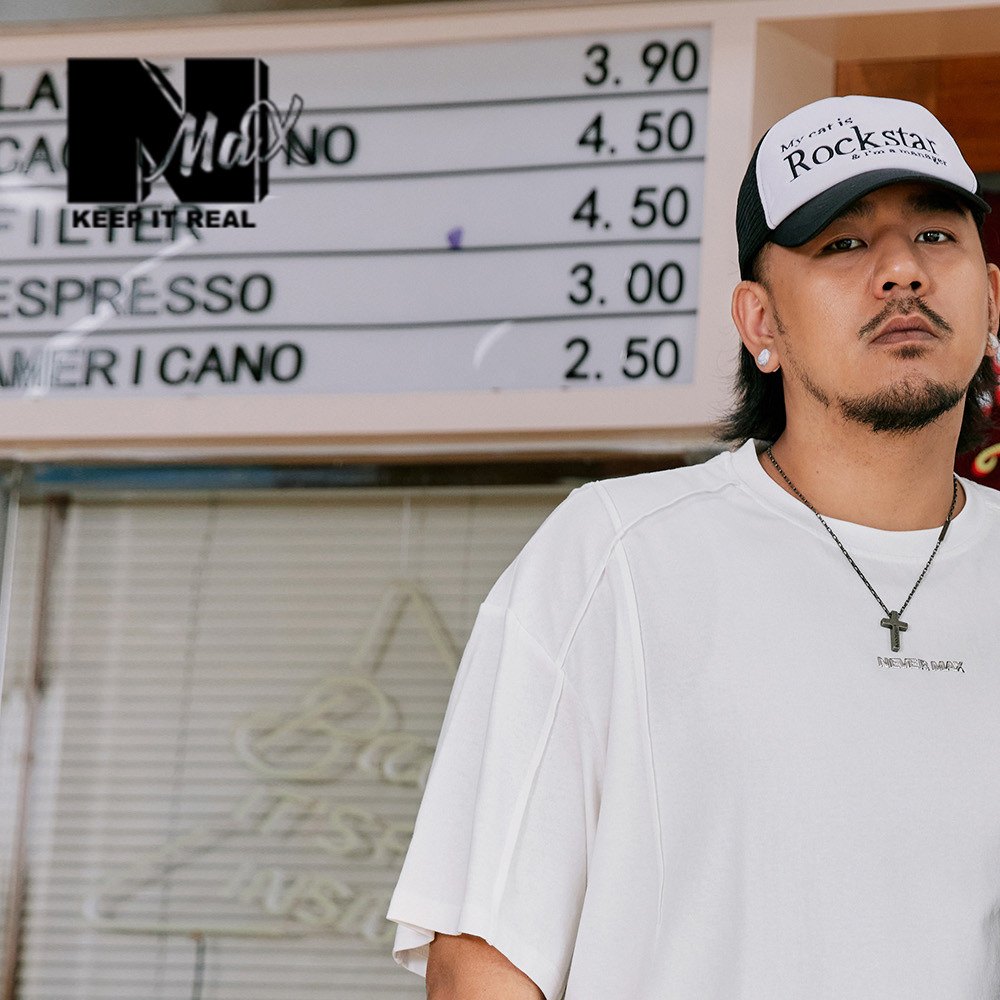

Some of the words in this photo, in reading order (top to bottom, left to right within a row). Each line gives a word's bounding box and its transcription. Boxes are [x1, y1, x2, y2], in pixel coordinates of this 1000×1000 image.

[780, 135, 805, 153] My
[808, 123, 834, 138] cat
[837, 117, 854, 127] is
[783, 125, 940, 183] Rockstar
[899, 148, 948, 166] manager
[877, 656, 931, 671] NEVER
[930, 660, 965, 673] MAX
